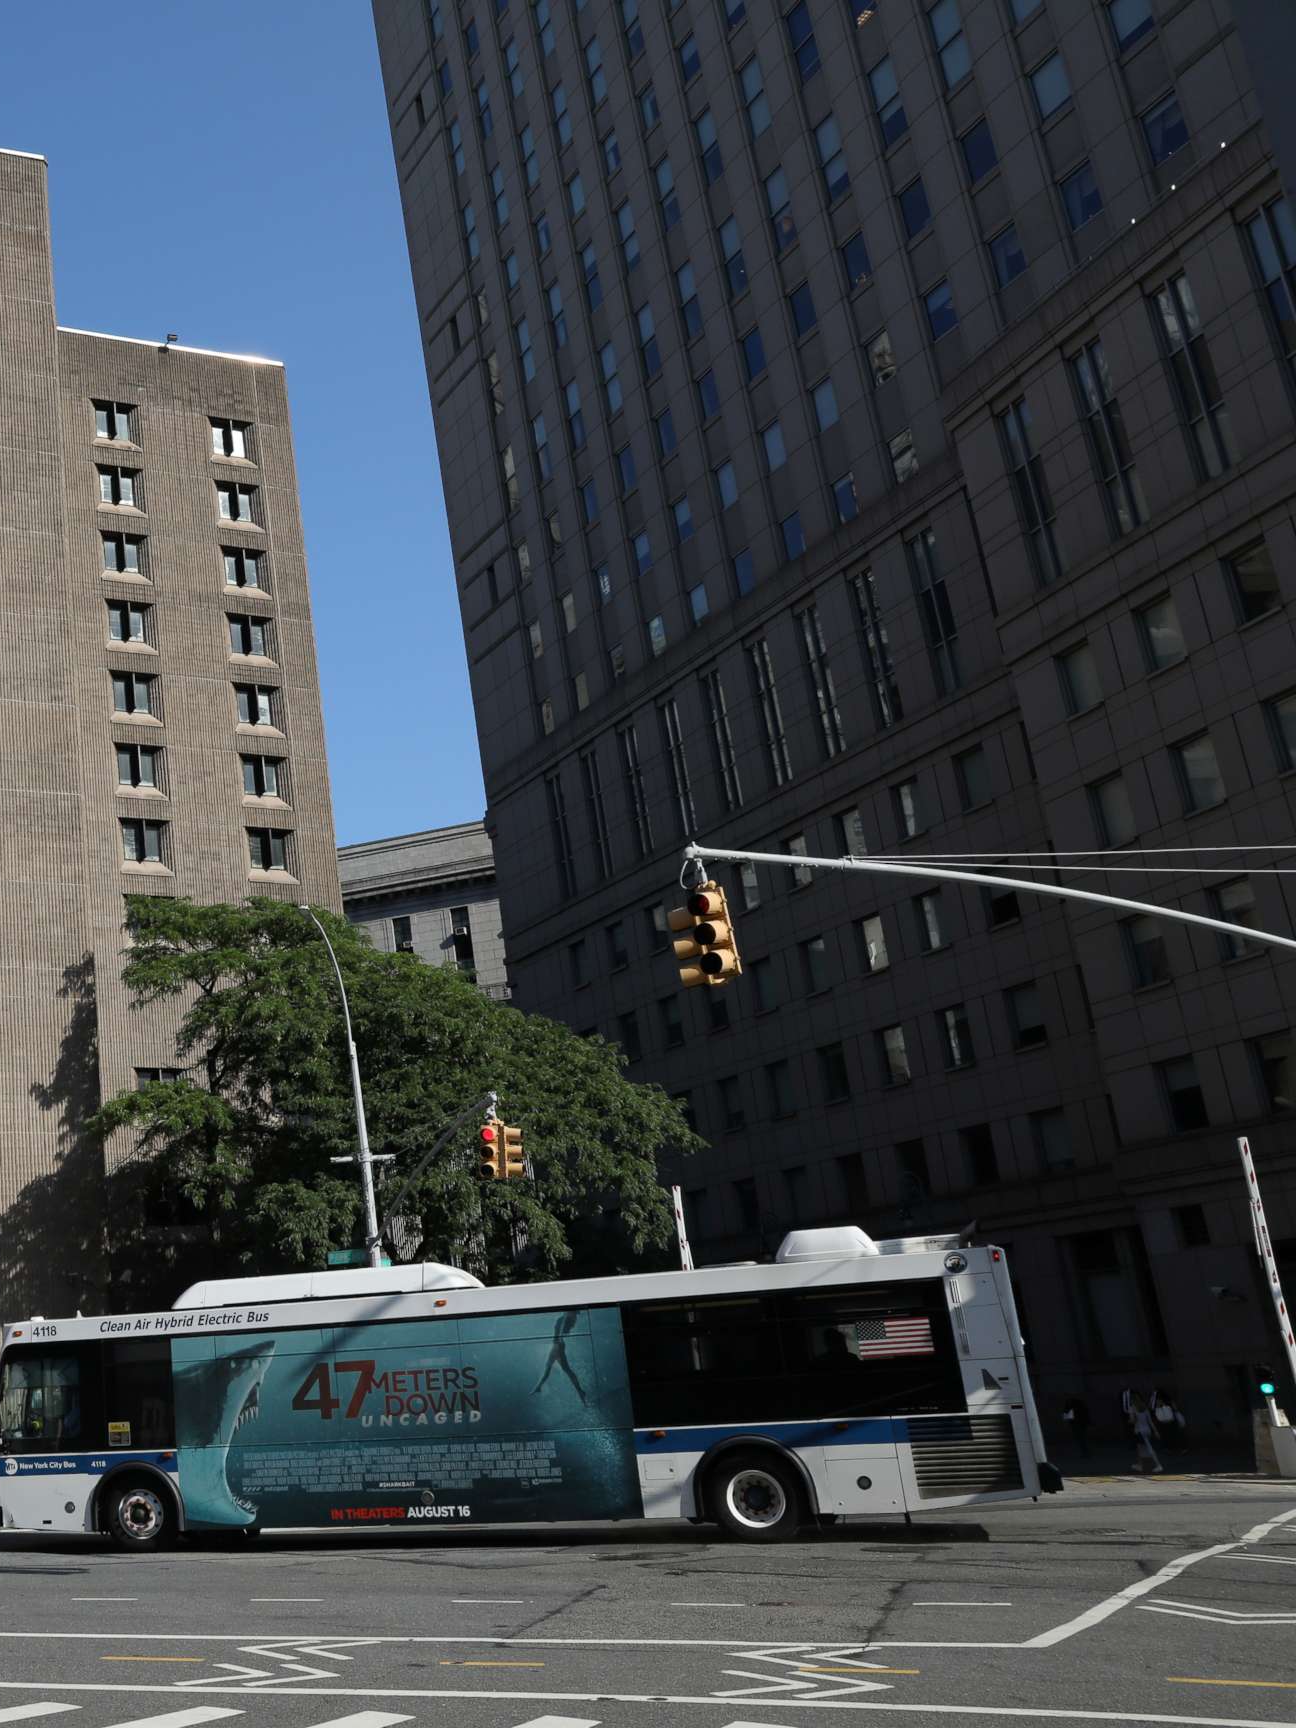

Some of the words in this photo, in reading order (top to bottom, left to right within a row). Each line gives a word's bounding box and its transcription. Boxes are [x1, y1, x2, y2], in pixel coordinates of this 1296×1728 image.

[99, 1319, 132, 1333] Clean
[134, 1317, 151, 1330] Air
[155, 1314, 194, 1331] Hybrid
[198, 1311, 245, 1327] Electric
[246, 1310, 270, 1323] Bus
[32, 1325, 57, 1338] 4118
[292, 1359, 376, 1420] 47
[368, 1366, 480, 1394] METERS
[385, 1390, 481, 1417] DOWN
[361, 1410, 482, 1428] UNCAGED
[19, 1462, 33, 1470] New
[34, 1461, 48, 1469] York
[49, 1461, 63, 1471] City
[63, 1461, 77, 1469] Bus
[90, 1460, 106, 1468] 4118
[331, 1509, 344, 1520] IN
[348, 1507, 404, 1520] THEATERS
[407, 1505, 455, 1518] AUGUST
[457, 1505, 471, 1517] 16
